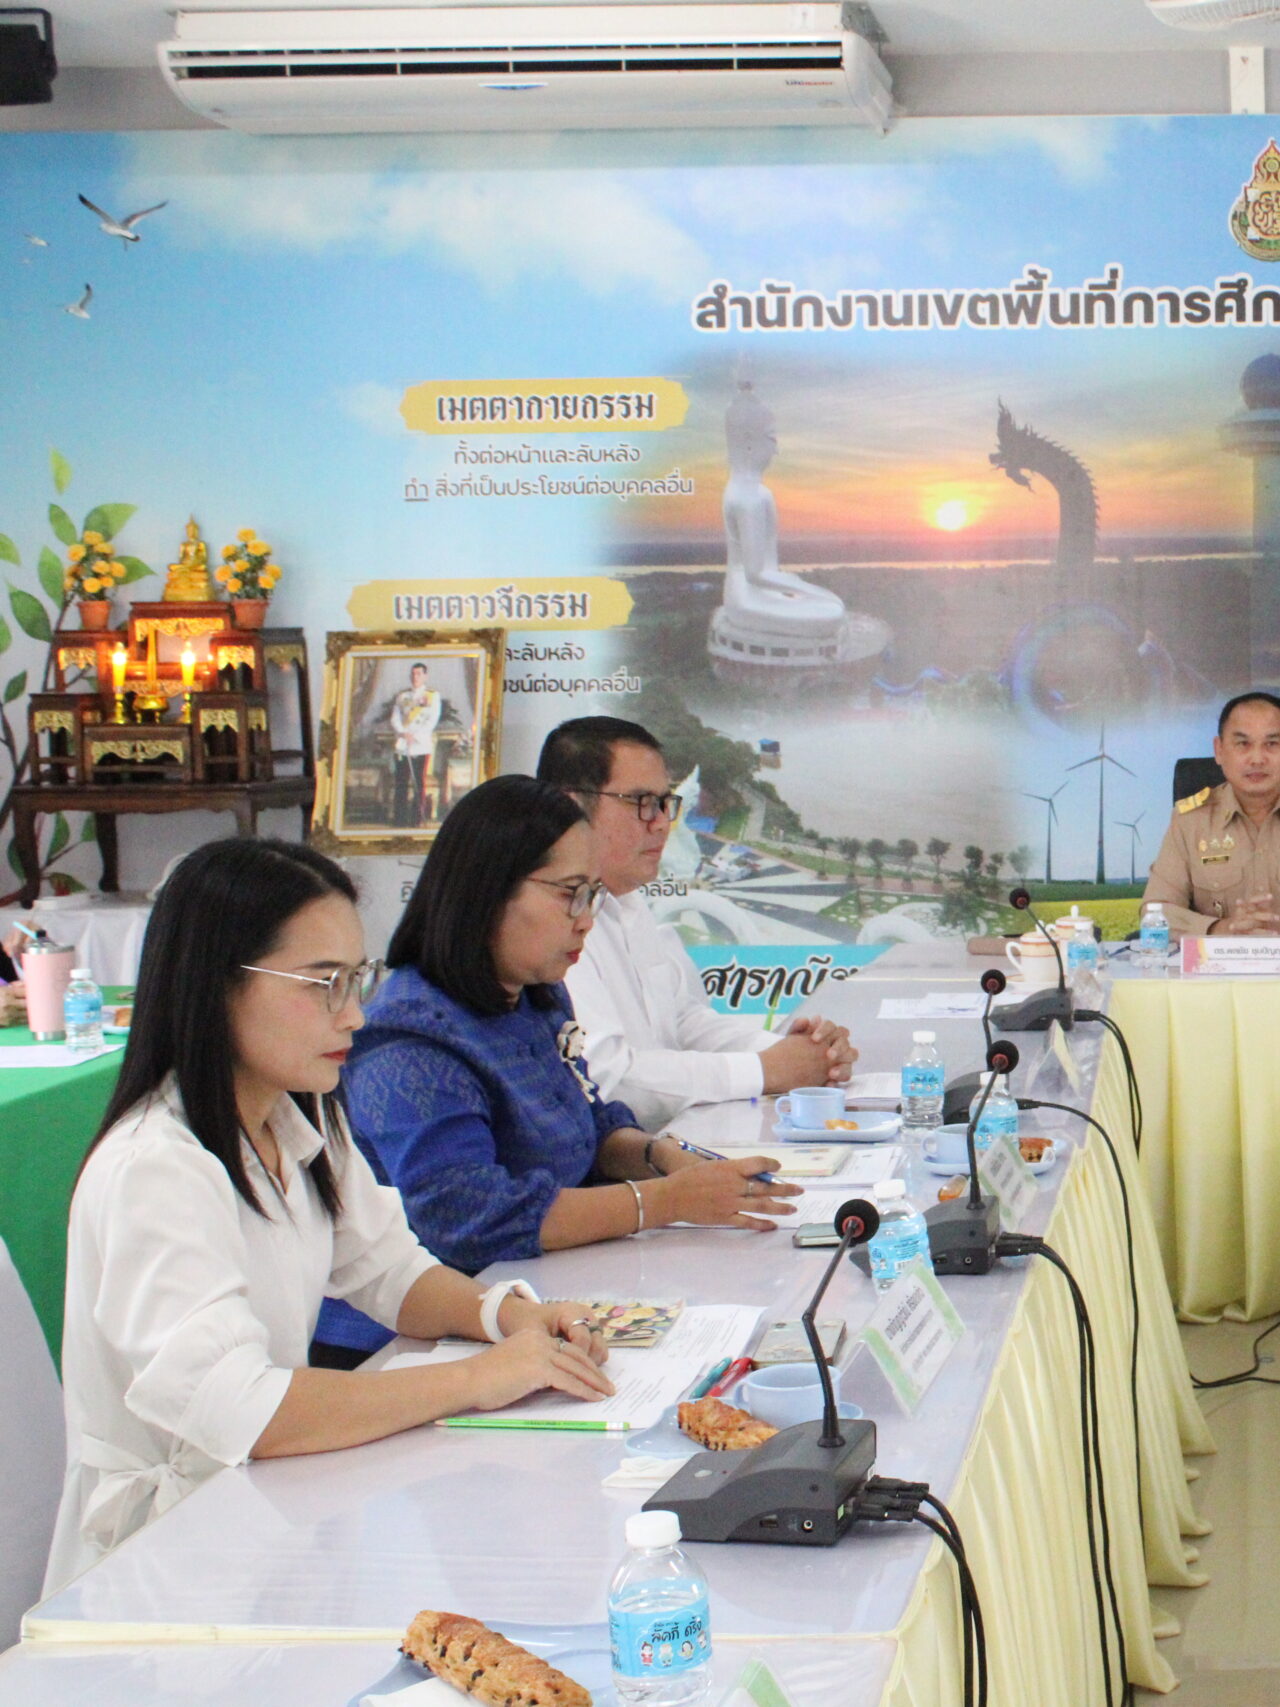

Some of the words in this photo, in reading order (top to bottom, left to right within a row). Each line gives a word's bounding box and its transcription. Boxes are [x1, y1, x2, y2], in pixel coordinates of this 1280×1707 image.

[437, 394, 654, 421] เมตตากายกรรม
[454, 440, 641, 465] ทั้งต่อหน้าและลับหลัง
[435, 469, 693, 499] สิ่งที่เป็นประโยชน์ต่อบุคคลอื่น
[394, 585, 589, 620] เมตตาวจีกรรม
